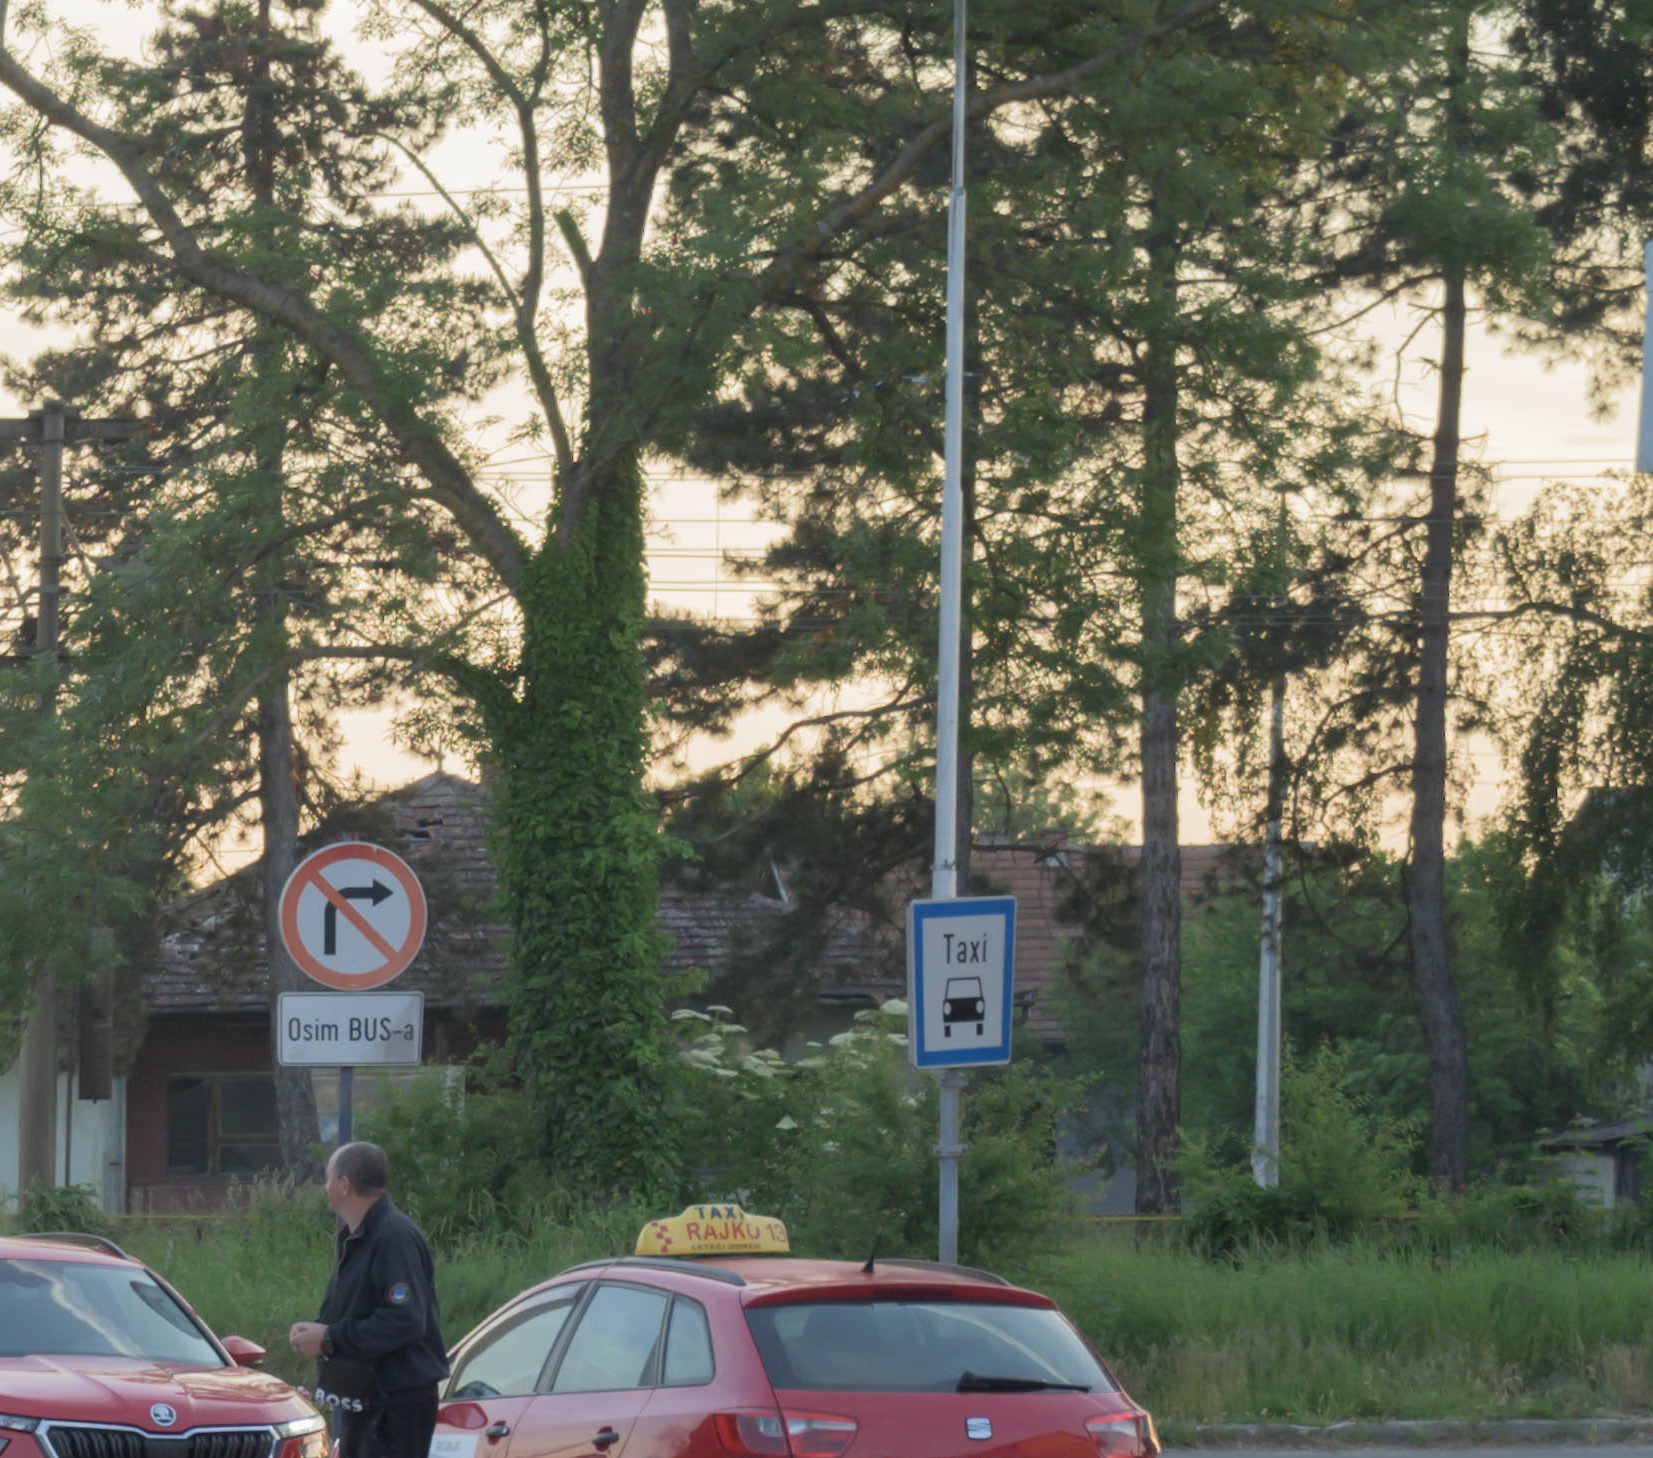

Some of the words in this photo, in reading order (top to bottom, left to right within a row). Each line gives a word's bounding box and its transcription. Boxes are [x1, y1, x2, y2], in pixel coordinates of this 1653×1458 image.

[943, 933, 987, 965] Taxi
[288, 1017, 339, 1042] Osim
[349, 1017, 414, 1042] BUS-a
[315, 1388, 363, 1412] BOSS
